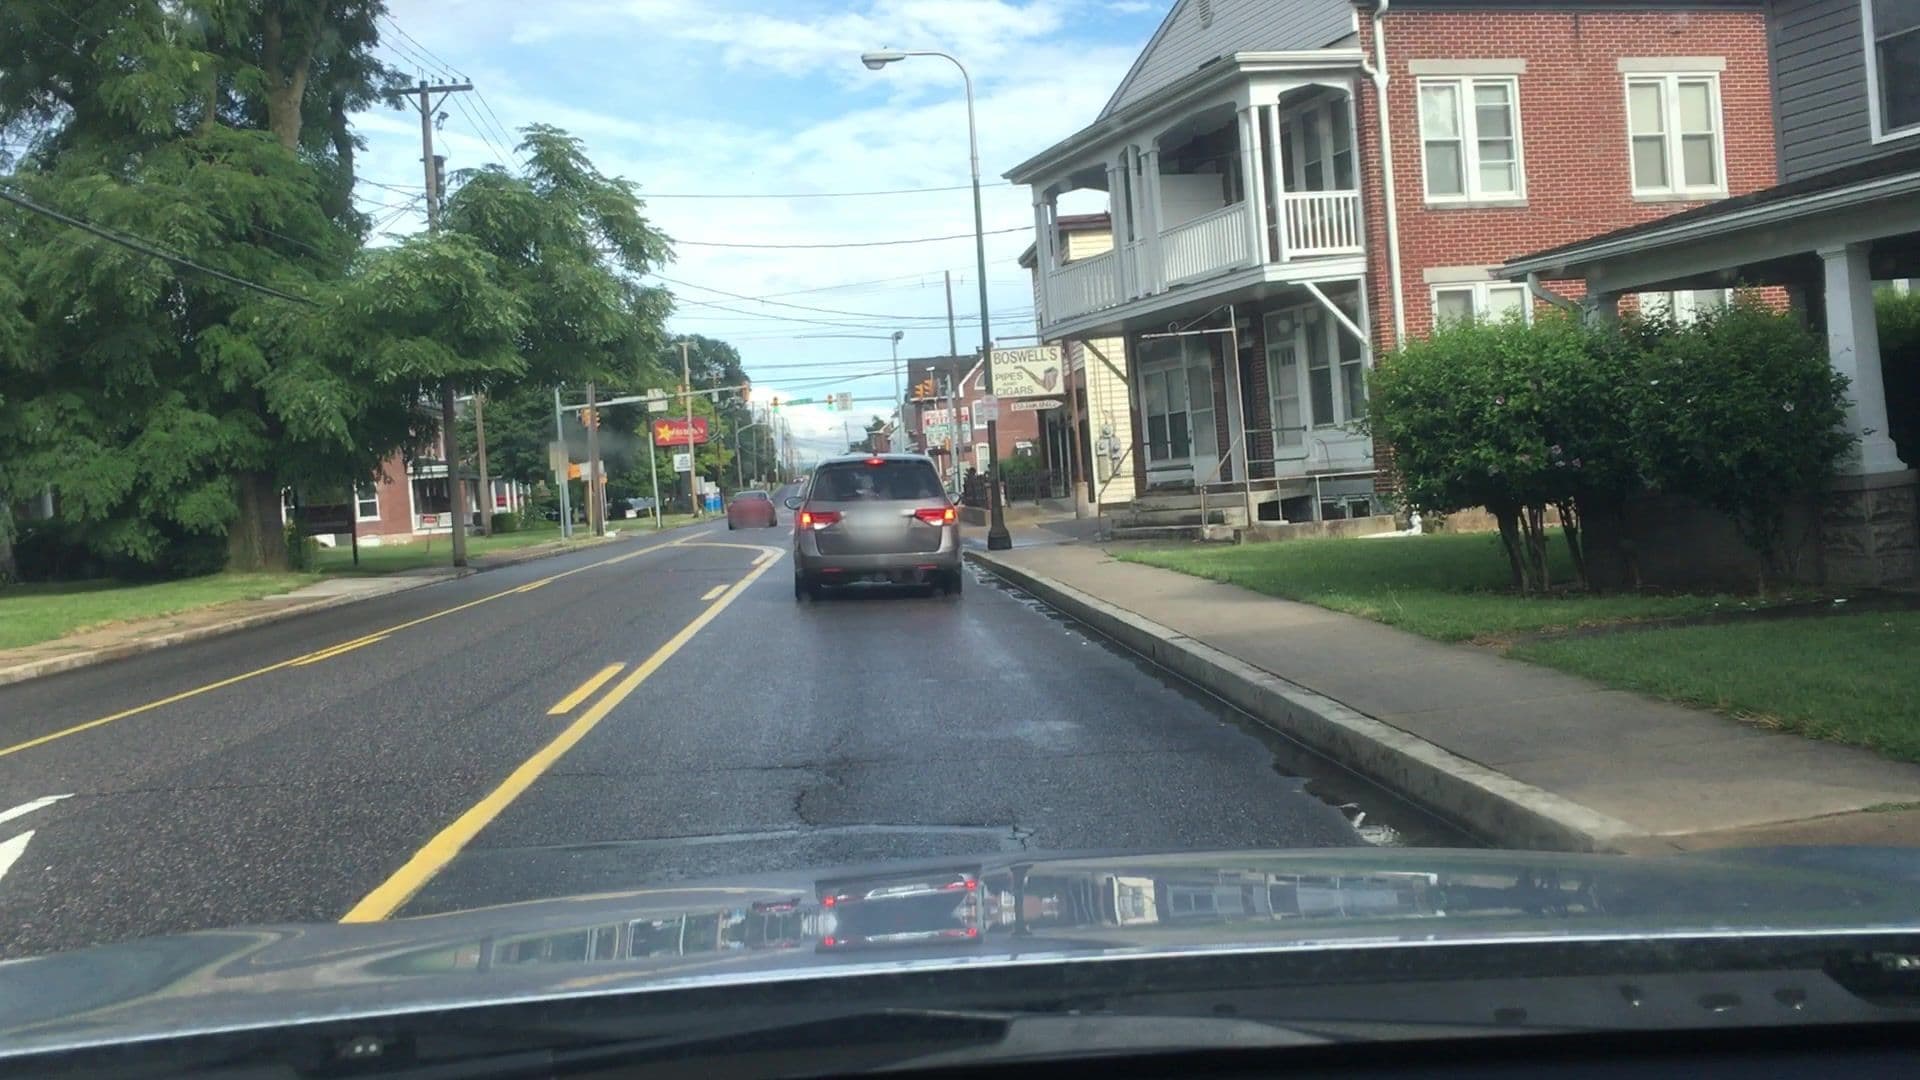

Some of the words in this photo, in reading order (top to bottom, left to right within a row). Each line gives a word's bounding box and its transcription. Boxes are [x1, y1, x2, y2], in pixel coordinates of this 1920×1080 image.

[993, 348, 1057, 365] BOSWELL'S
[995, 371, 1023, 381] PIPES
[996, 385, 1034, 396] CIGARS
